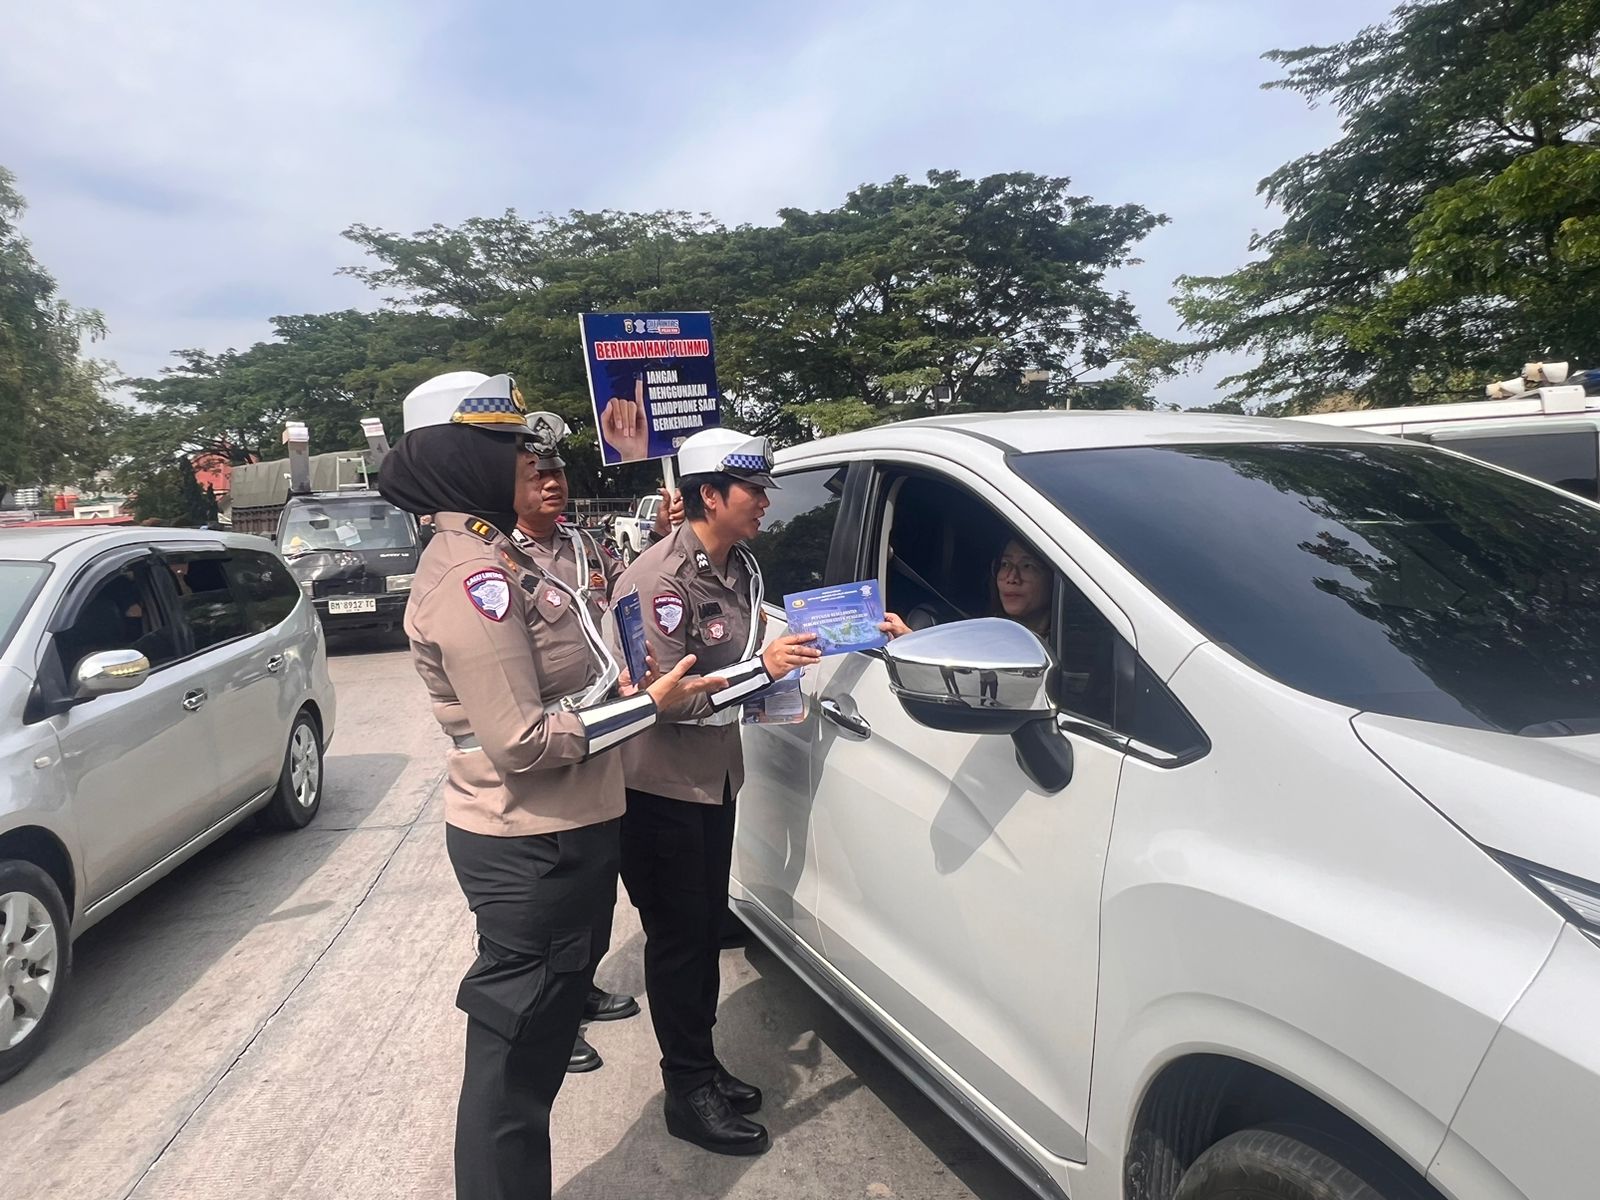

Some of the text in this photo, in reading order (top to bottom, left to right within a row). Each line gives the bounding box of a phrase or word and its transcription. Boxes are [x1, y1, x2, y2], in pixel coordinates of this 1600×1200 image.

[595, 339, 709, 360] BERIKAN HAK PILIHMU
[646, 370, 678, 384] JANGAN
[648, 384, 708, 400] MENGGUNAKAN
[650, 398, 716, 416] HANDPHONE SAAT
[652, 414, 703, 431] BERKENDARA
[330, 600, 375, 610] BM 8912 TC
